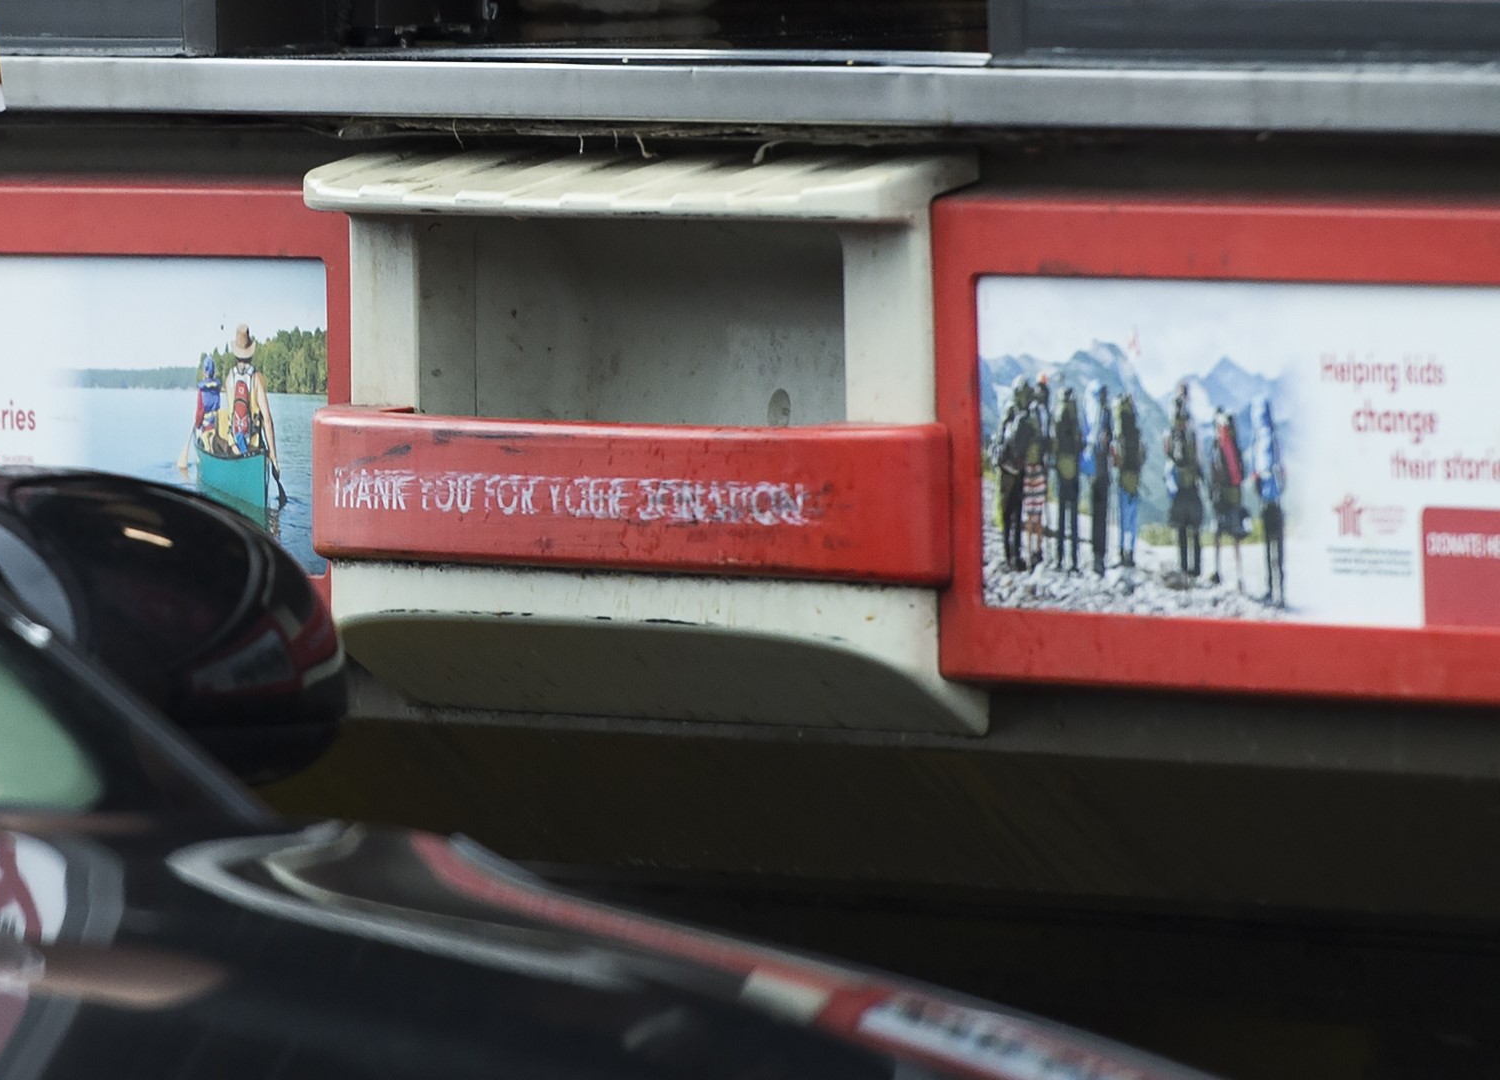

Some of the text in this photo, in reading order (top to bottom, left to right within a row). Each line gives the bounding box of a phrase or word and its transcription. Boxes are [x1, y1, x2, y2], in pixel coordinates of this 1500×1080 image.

[1320, 353, 1446, 393] Helping kids
[1351, 400, 1438, 444] change
[1390, 449, 1436, 480] their
